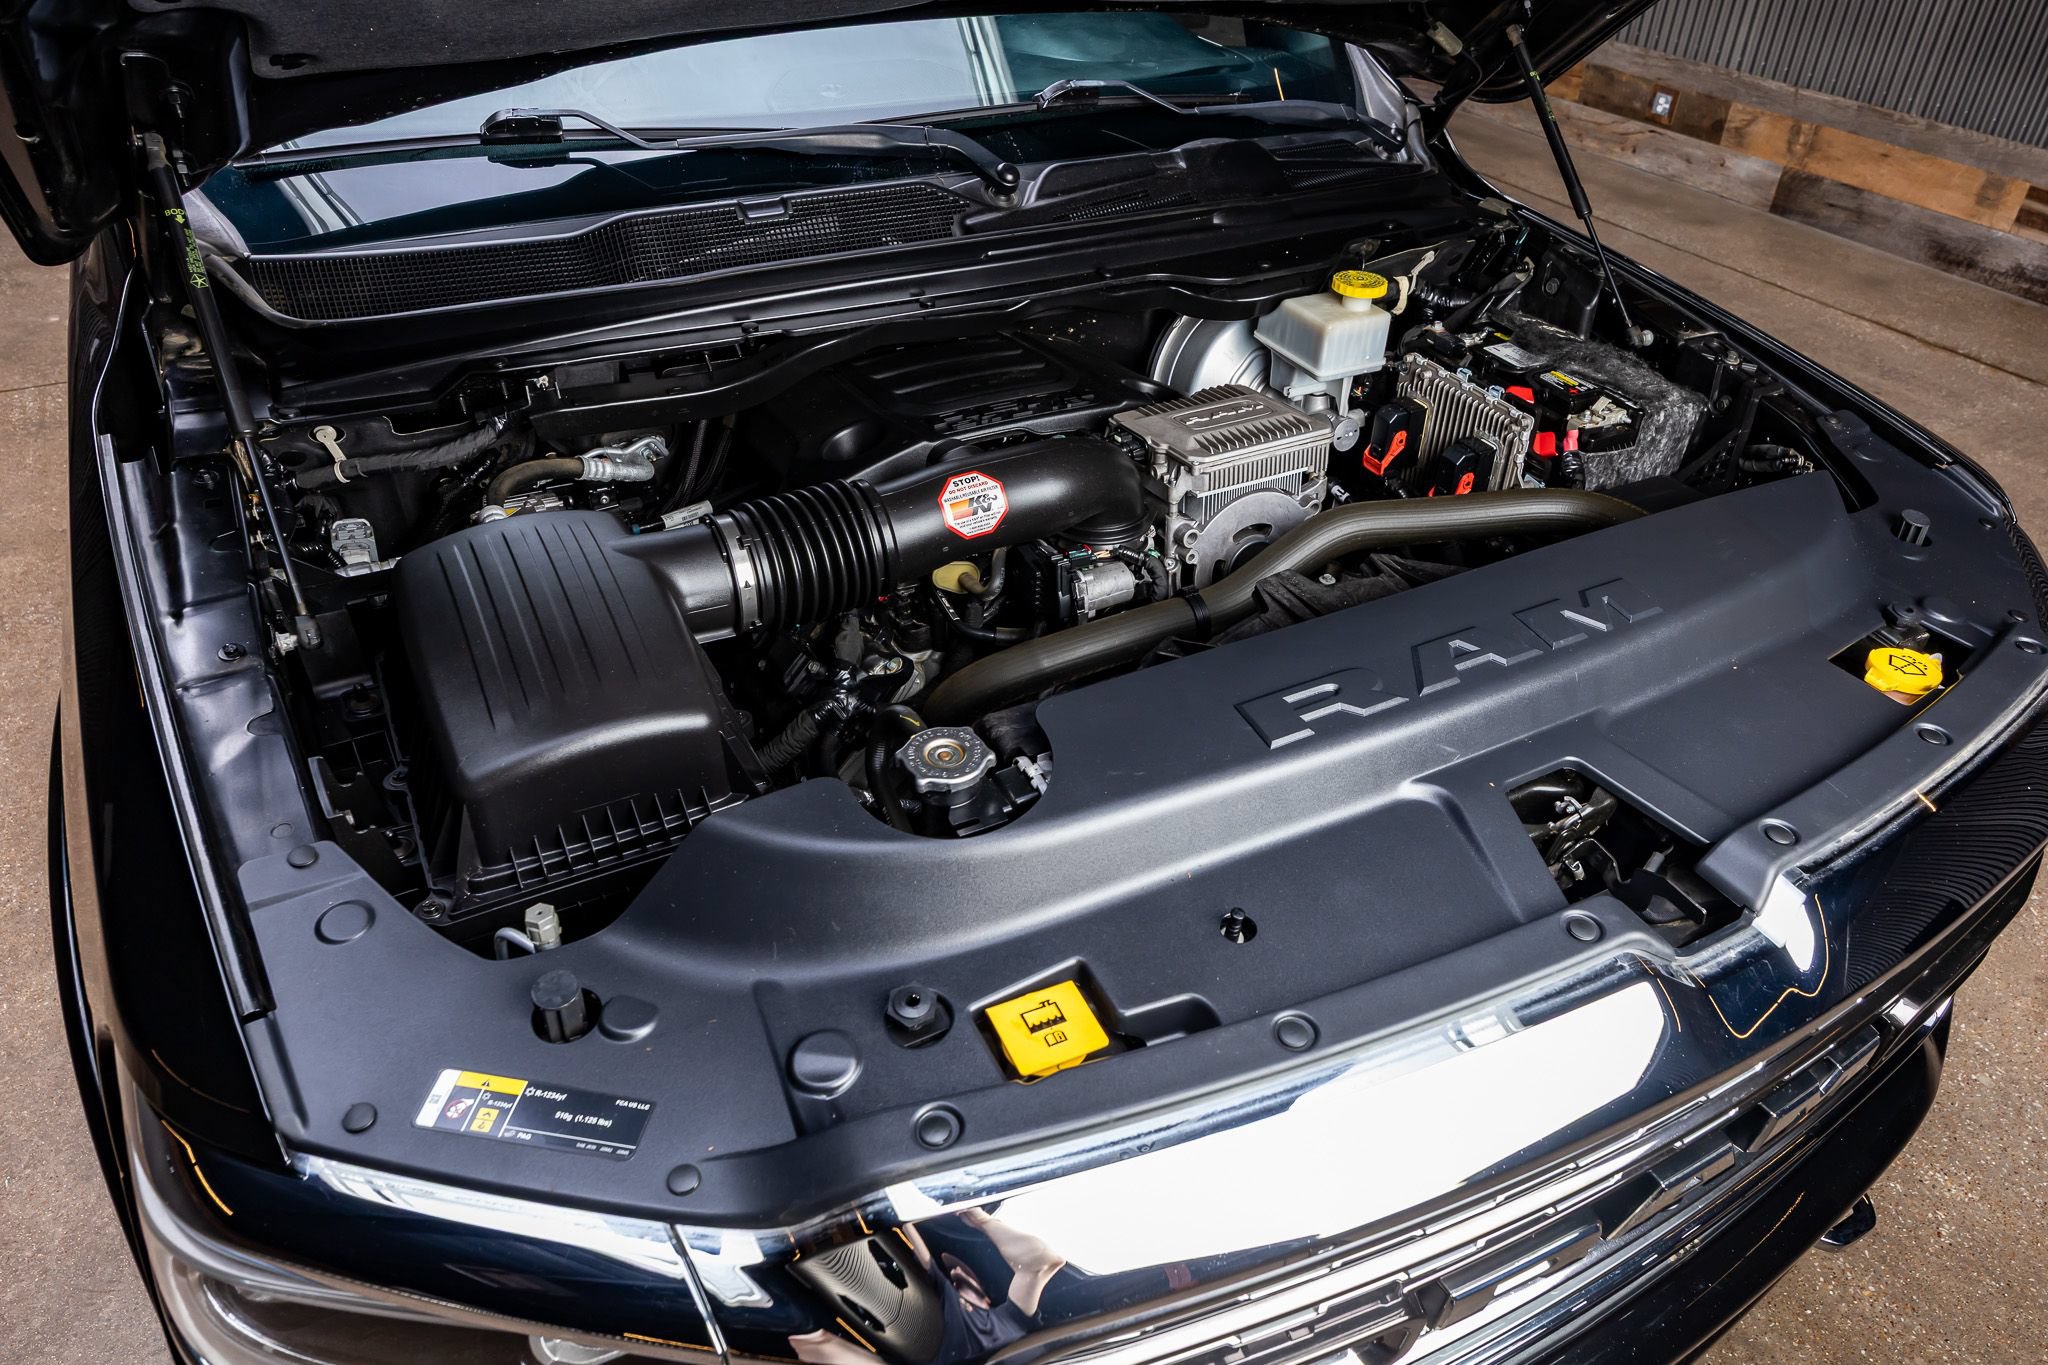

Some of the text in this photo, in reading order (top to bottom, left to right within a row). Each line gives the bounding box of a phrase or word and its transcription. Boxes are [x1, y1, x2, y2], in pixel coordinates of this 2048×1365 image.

[165, 208, 185, 217] BOD
[953, 475, 980, 487] STOP!
[968, 481, 988, 489] DISCARD
[1233, 577, 1664, 749] RAM
[534, 1088, 568, 1102] R-1234yf
